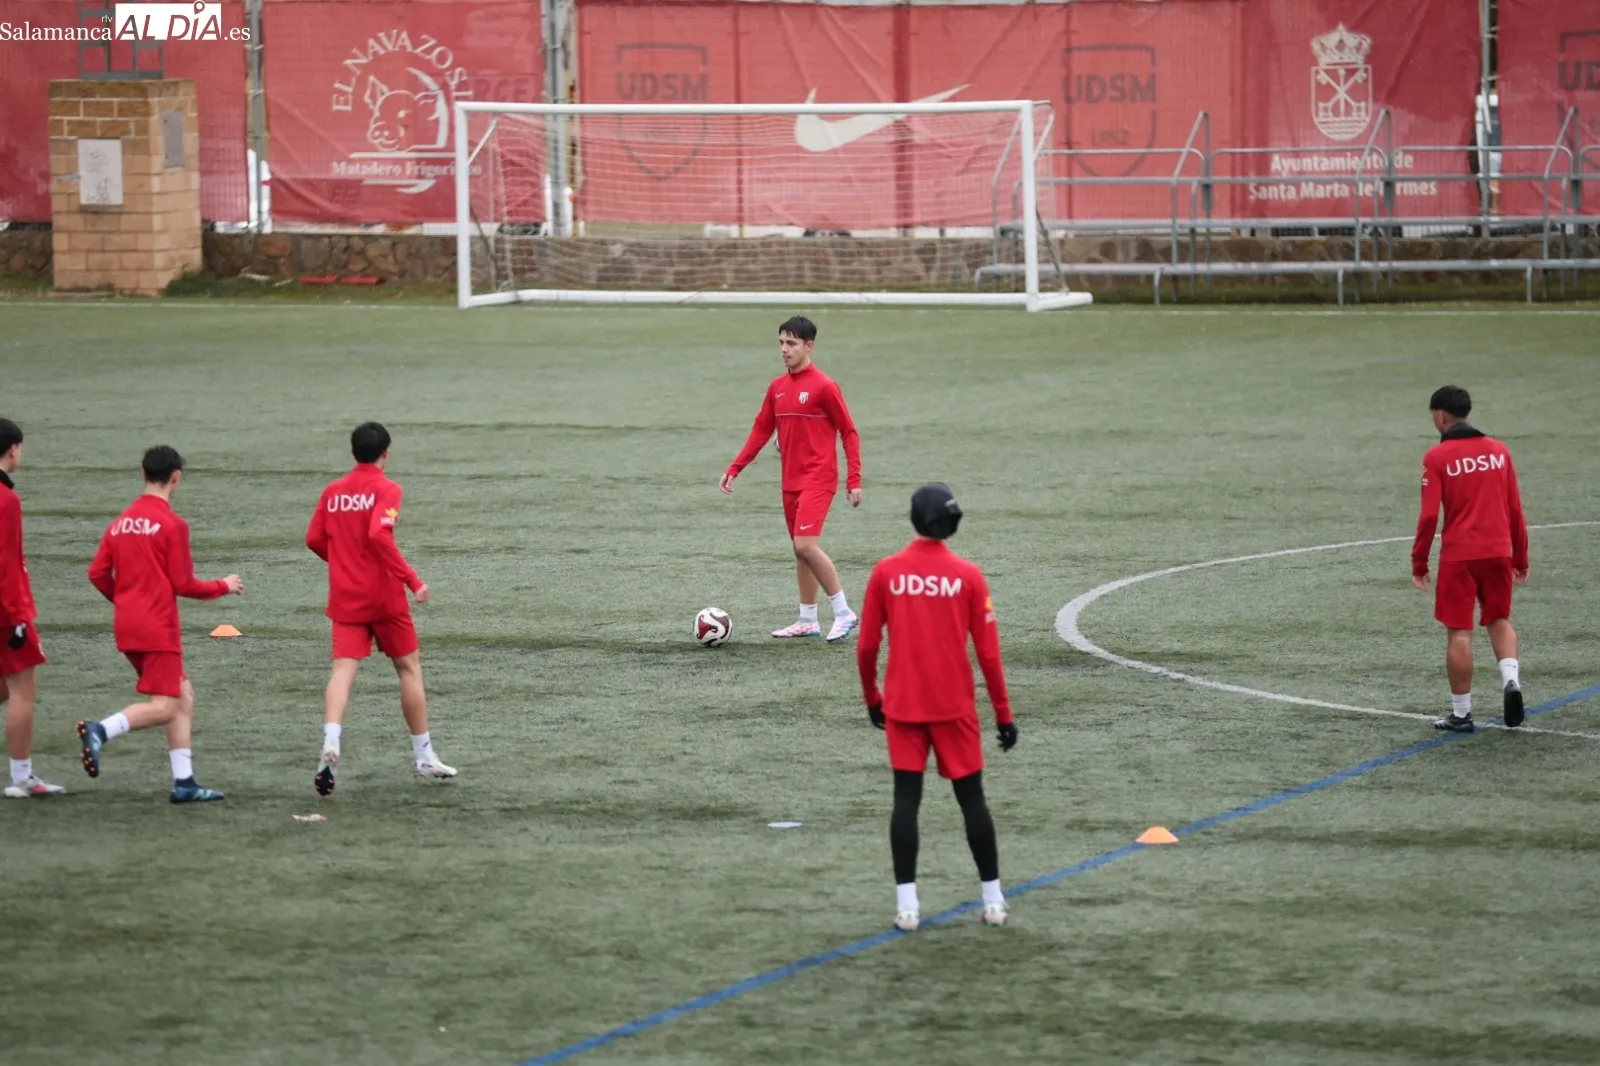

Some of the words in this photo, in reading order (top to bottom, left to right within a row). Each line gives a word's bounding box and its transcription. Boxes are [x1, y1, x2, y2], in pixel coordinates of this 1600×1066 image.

[331, 78, 356, 112] EL
[615, 71, 709, 101] UDSM
[1061, 72, 1156, 104] UDSM
[331, 161, 401, 176] Matadero
[1392, 151, 1414, 168] de
[1249, 182, 1298, 201] Santa
[1300, 181, 1350, 199] Marta
[1446, 453, 1505, 477] UDSM
[327, 493, 375, 513] UDSM
[111, 517, 161, 536] UDSM
[889, 573, 962, 598] UDSM
